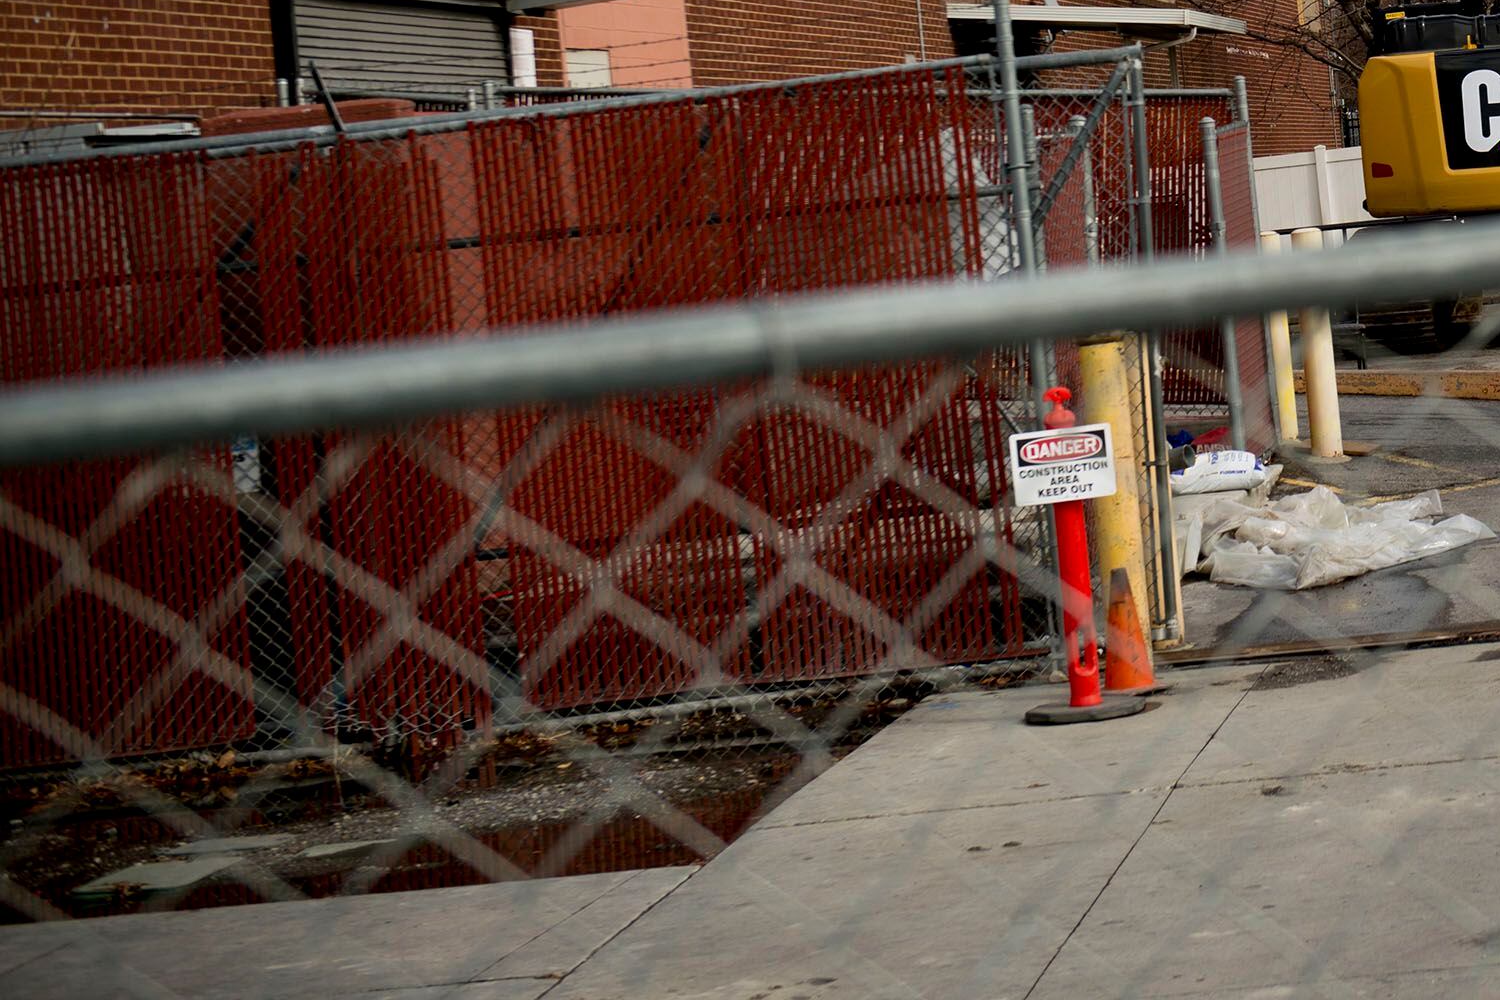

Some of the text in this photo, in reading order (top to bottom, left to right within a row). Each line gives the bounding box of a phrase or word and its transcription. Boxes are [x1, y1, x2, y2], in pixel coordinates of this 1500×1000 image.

[1025, 437, 1098, 460] DANGER
[1019, 460, 1109, 479] CONSTRUCTION
[1050, 475, 1080, 487] AREA
[1037, 482, 1094, 498] KEEP OUT
